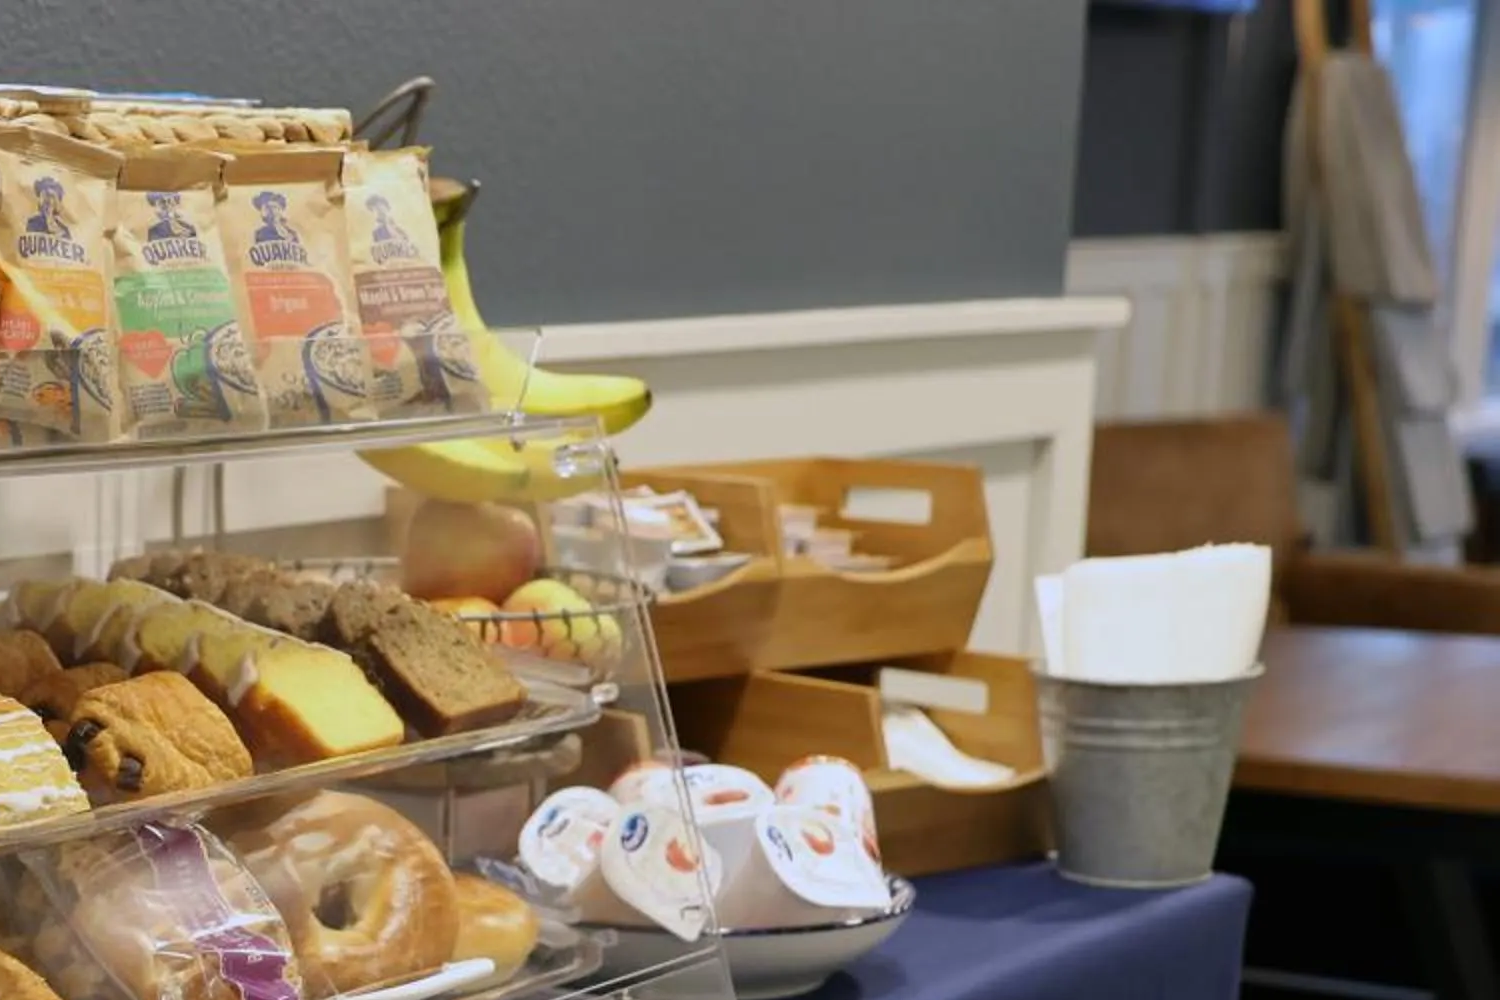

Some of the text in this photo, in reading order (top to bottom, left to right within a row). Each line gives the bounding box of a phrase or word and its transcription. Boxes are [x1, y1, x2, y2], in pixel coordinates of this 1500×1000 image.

[18, 235, 85, 263] QUAKER
[142, 238, 207, 266] QUAKER
[249, 241, 308, 267] QUAKER
